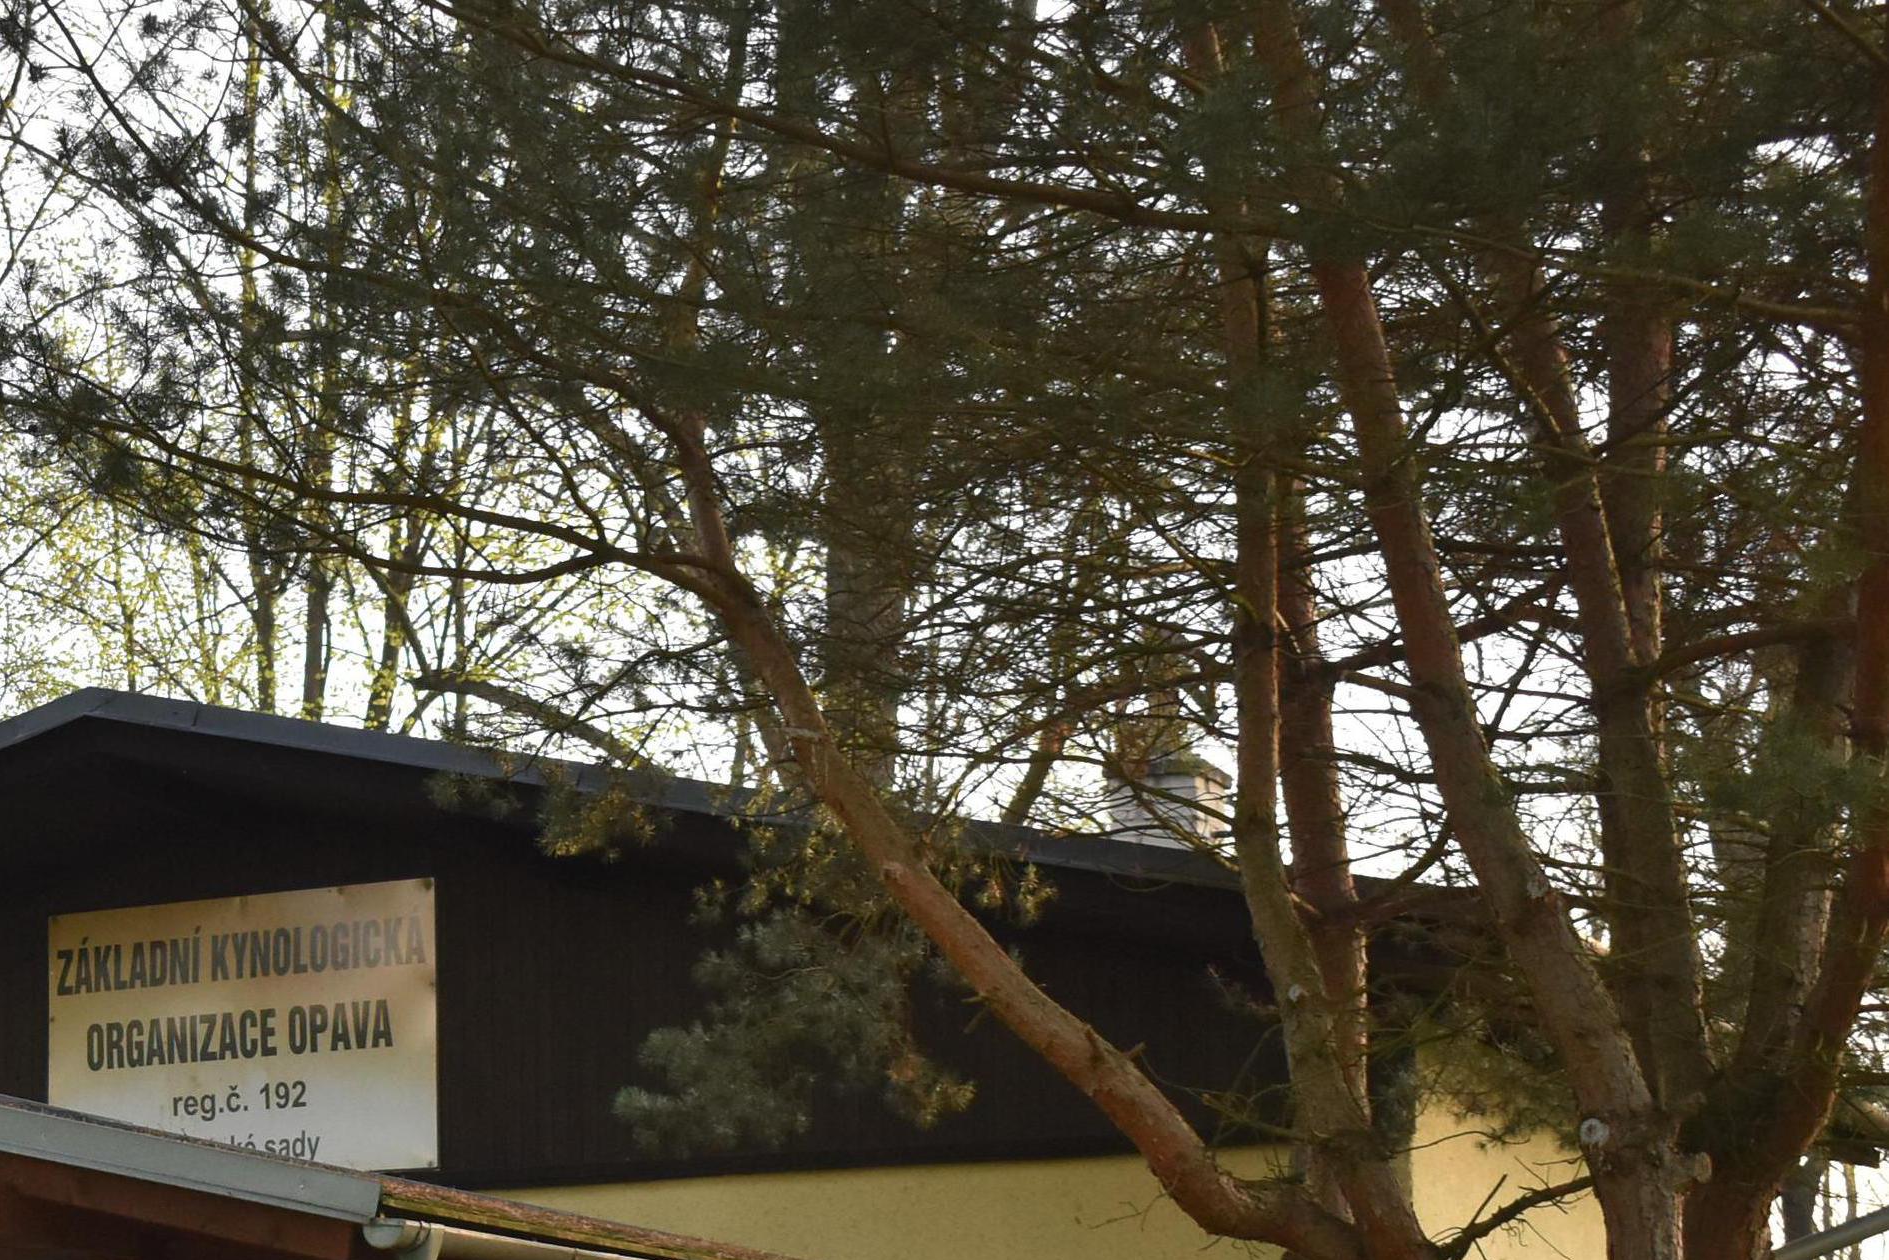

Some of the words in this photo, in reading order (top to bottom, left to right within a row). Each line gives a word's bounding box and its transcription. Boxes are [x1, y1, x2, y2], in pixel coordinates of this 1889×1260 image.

[57, 926, 201, 996] ZÁKLADNÍ
[86, 1011, 277, 1071] ORGANIZACE
[288, 999, 393, 1055] OPAVA
[172, 1084, 248, 1121] reg.č.
[259, 1080, 307, 1110] 192
[264, 1129, 320, 1160] sady
